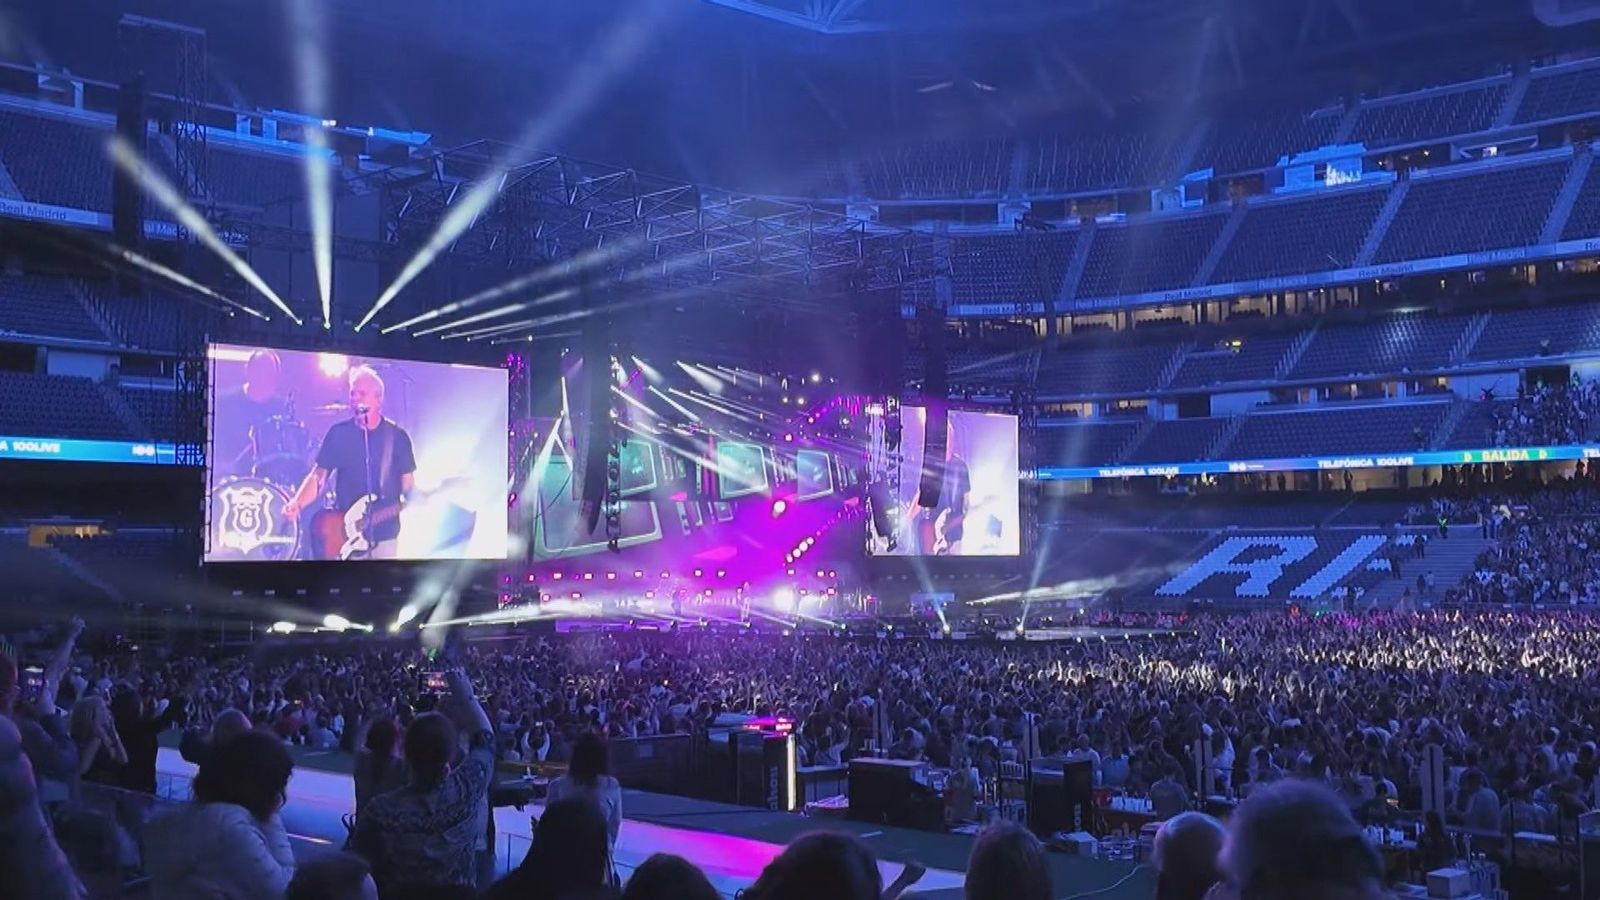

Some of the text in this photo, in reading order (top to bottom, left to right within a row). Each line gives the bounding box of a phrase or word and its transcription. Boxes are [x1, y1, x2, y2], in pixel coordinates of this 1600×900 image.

[26, 206, 67, 220] Madrid
[1358, 264, 1413, 278] Real Madrid
[1482, 450, 1528, 461] SALIDA
[1318, 458, 1373, 468] TELEFÓNICA
